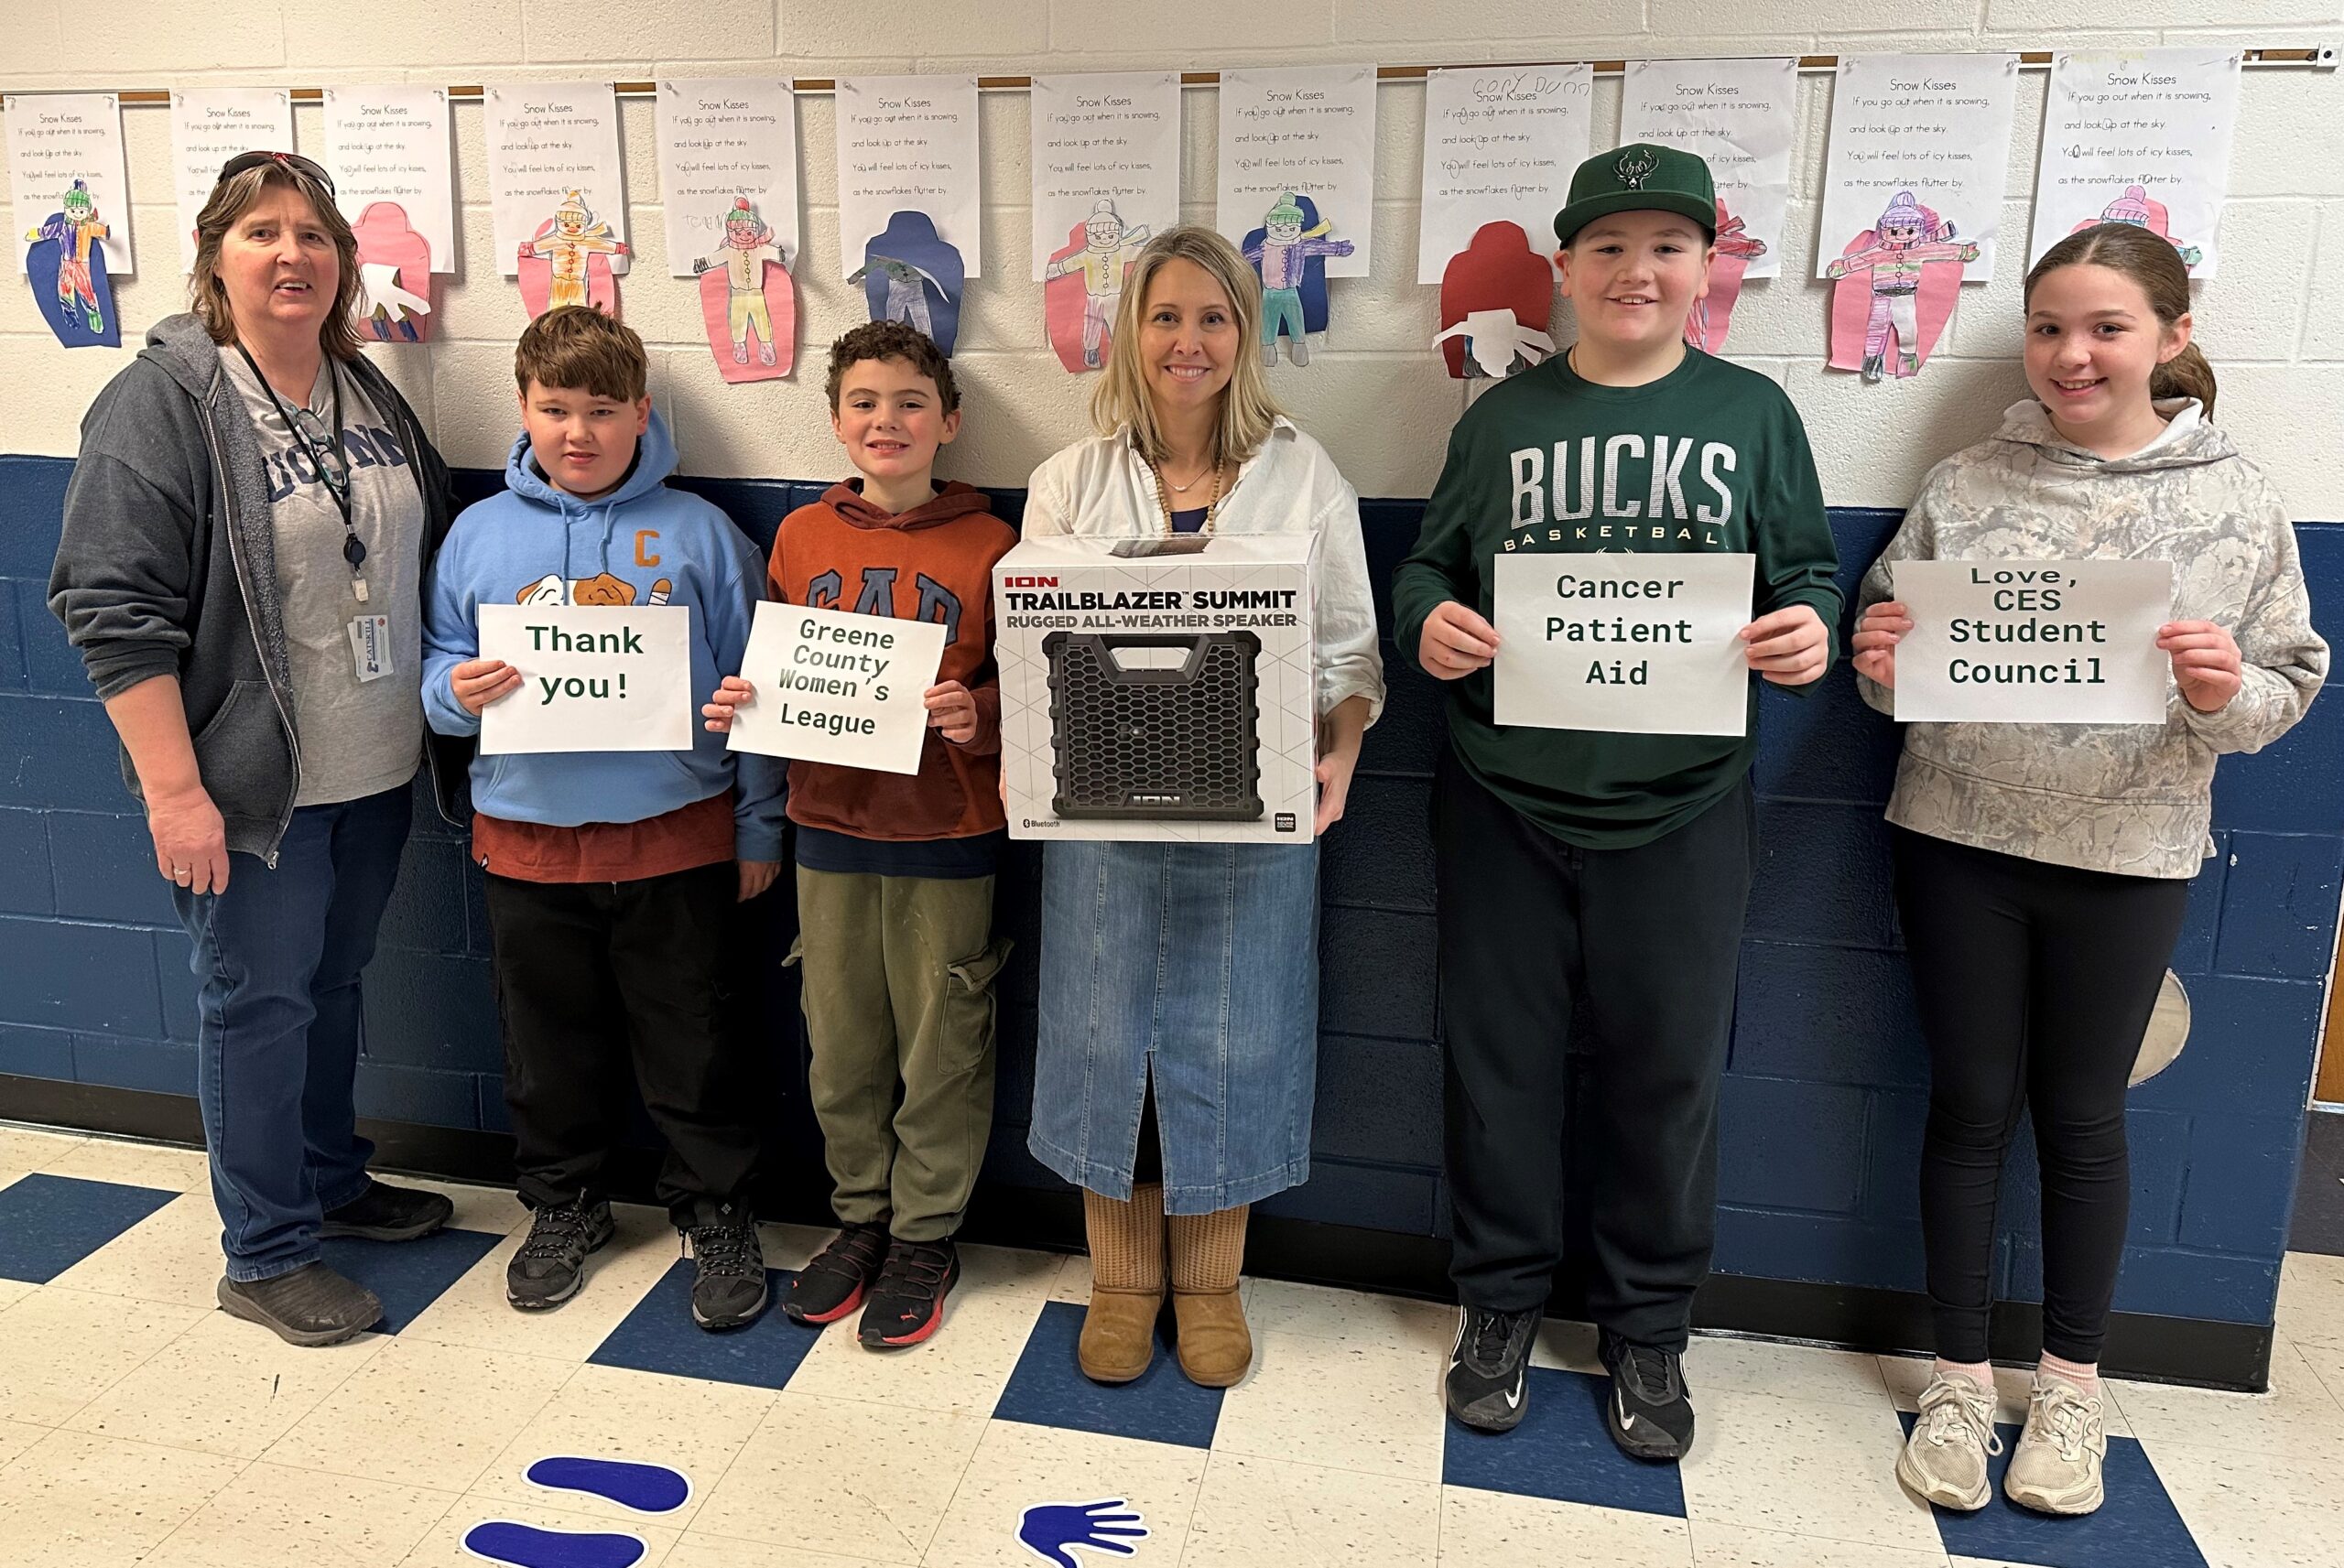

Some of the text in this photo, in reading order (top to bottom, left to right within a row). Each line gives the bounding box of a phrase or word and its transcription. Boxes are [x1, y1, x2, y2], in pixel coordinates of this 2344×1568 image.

[1890, 78, 1956, 91] Snow Kisses
[2108, 72, 2176, 86] Snow Kisses
[1676, 82, 1738, 95] Snow Kisses
[1077, 95, 1131, 107] Snow Kisses
[1267, 89, 1324, 102] Snow Kisses
[1476, 91, 1537, 103] Snow Kisses
[2068, 92, 2076, 102] If
[2078, 94, 2094, 103] you
[2097, 94, 2109, 104] go
[2113, 92, 2127, 101] out
[2132, 92, 2153, 100] when
[2156, 92, 2162, 100] it
[524, 103, 572, 114] Snow Kisses
[699, 99, 749, 110] Snow Kisses
[879, 97, 930, 109] Snow Kisses
[1641, 102, 1648, 111] If
[1668, 103, 1678, 114] go
[1698, 102, 1718, 110] when
[1853, 96, 1860, 106] If
[1862, 99, 1877, 110] you
[1881, 99, 1892, 109] go
[1895, 98, 1910, 106] out
[1913, 97, 1934, 105] when
[207, 107, 250, 117] Snow Kisses
[361, 104, 407, 115] Snow Kisses
[39, 113, 82, 124] Snow Kisses
[2065, 121, 2080, 129] and
[2084, 120, 2101, 129] look
[2133, 119, 2147, 128] the
[1639, 129, 1654, 137] and
[1657, 128, 1673, 137] look
[1850, 124, 1865, 133] and
[1869, 124, 1885, 133] look
[1889, 125, 1900, 135] up
[1904, 124, 1913, 133] at
[1916, 124, 1929, 133] the
[1848, 151, 1864, 160] You
[1867, 151, 1878, 160] will
[1882, 151, 1899, 160] feel
[1903, 151, 1916, 160] lots
[1920, 151, 1930, 159] of
[1933, 151, 1945, 161] icy
[2082, 146, 2093, 157] will
[2098, 146, 2115, 157] feel
[2118, 146, 2133, 157] lots
[2137, 146, 2146, 156] of
[2151, 147, 2163, 157] icy
[1265, 158, 1280, 167] feel
[1283, 157, 1295, 166] lots
[1298, 157, 1307, 165] of
[1309, 157, 1319, 167] icy
[1707, 154, 1717, 162] of
[1719, 155, 1730, 164] icy
[1856, 178, 1870, 187] the
[1873, 178, 1918, 187] snowflakes
[1922, 178, 1948, 187] flutter
[2071, 176, 2084, 184] the
[2088, 175, 2134, 184] snowflakes
[2138, 174, 2166, 184] flutter
[700, 187, 733, 195] snowflakes
[876, 187, 911, 195] snowflakes
[1072, 188, 1110, 196] snowflakes
[1466, 185, 1507, 194] snowflakes
[1510, 433, 1737, 530] BUCKS
[634, 530, 660, 567] C
[1004, 577, 1058, 588] ION
[1970, 568, 2077, 588] Love,
[1557, 574, 1684, 599] Cancer
[1192, 590, 1297, 610] SUMMIT
[1993, 589, 2061, 611] CES
[1006, 614, 1297, 628] RUGGED ALL-WEATHER SPEAKER
[799, 619, 895, 650] Greene
[1546, 616, 1692, 643] Patient
[1949, 618, 2106, 643] Student
[526, 625, 644, 654] Thank
[793, 644, 890, 679] County
[1586, 660, 1647, 685] Aid
[1948, 658, 2106, 684] Council
[539, 674, 627, 706] you!
[778, 668, 890, 701] Women's
[780, 703, 876, 736] League
[1133, 795, 1180, 806] ION
[1031, 818, 1060, 828] Bluetooth
